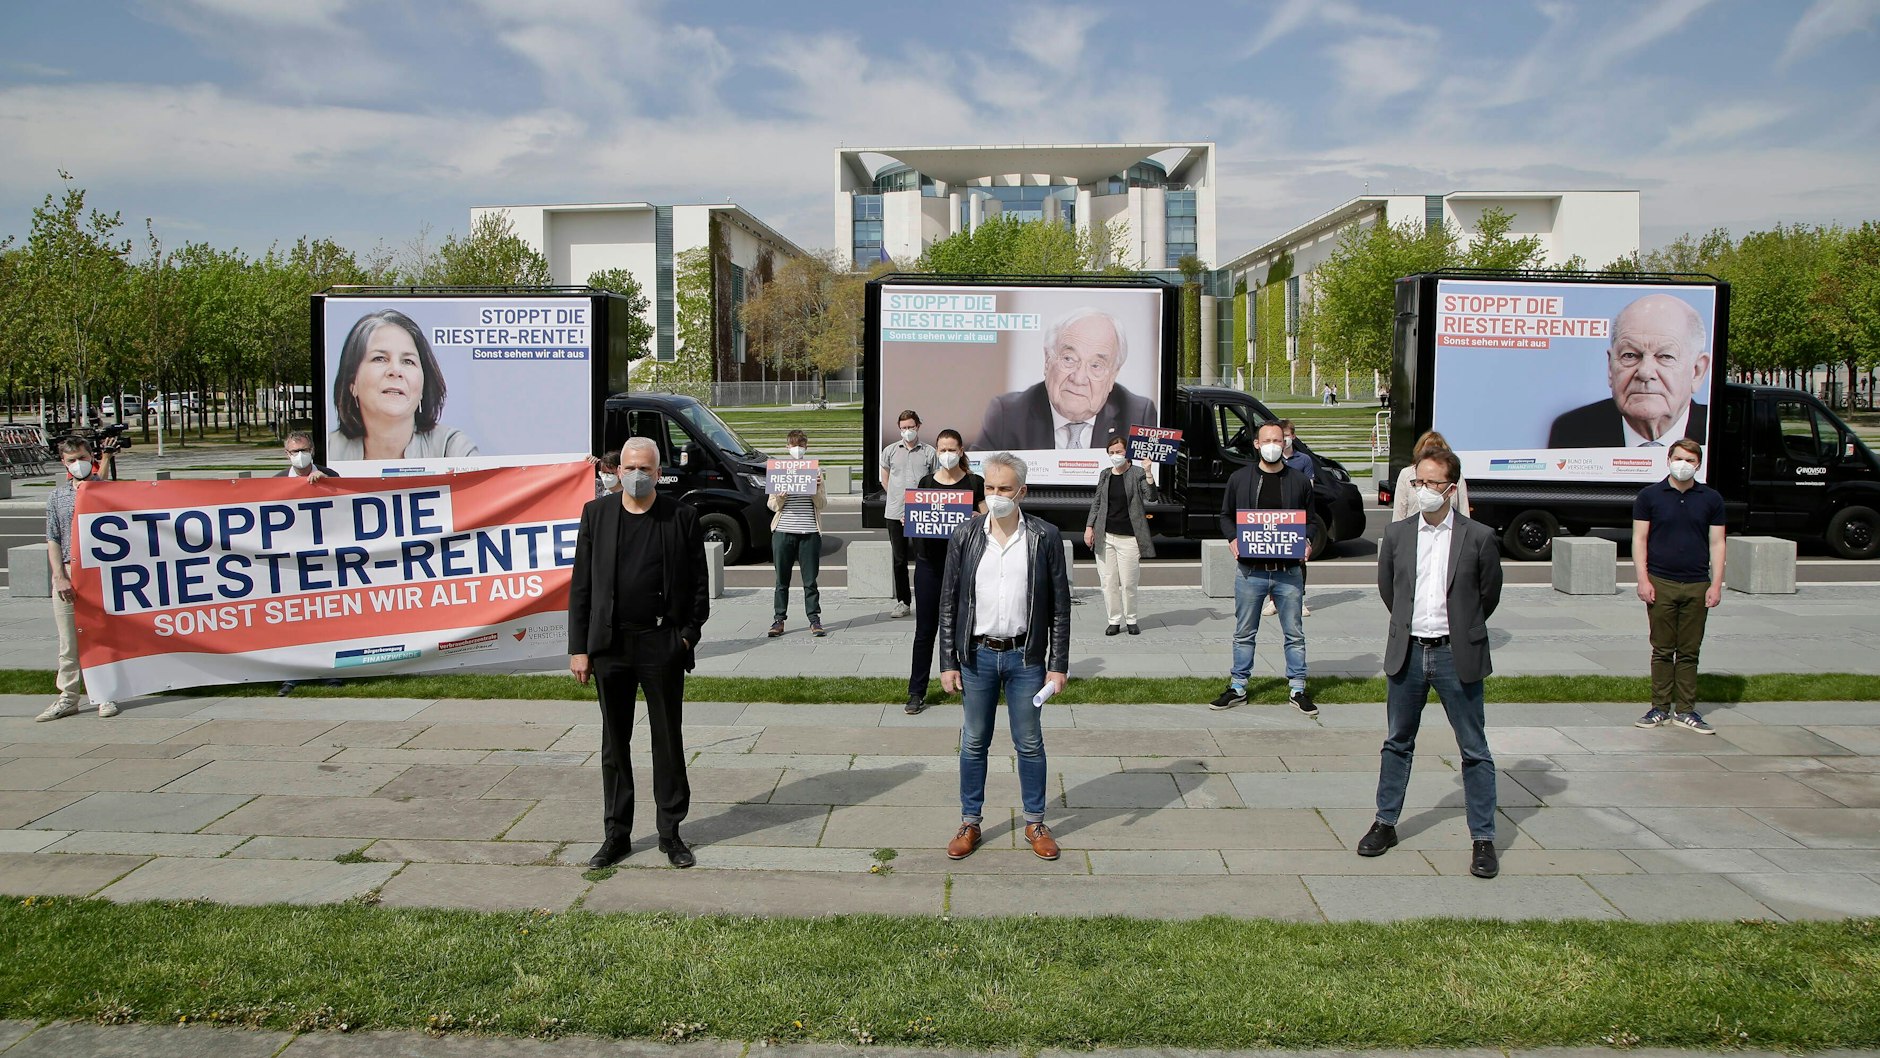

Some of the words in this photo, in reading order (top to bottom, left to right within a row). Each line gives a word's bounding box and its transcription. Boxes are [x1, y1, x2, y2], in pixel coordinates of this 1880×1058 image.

[890, 295, 960, 310] STOPPT
[964, 296, 993, 311] DIE
[1444, 295, 1522, 314] STOPPT
[1526, 298, 1558, 315] DIE
[481, 309, 551, 324] STOPPT
[556, 309, 585, 324] DIE
[890, 313, 1039, 329] RIESTER-RENTE!
[1444, 316, 1608, 337] RIESTER-RENTE!
[434, 329, 584, 344] RIESTER-RENTE!
[889, 331, 916, 340] Sonst
[917, 332, 945, 340] sehen
[947, 332, 962, 341] wir
[963, 332, 976, 341] alt
[977, 333, 994, 341] aus
[1443, 336, 1470, 346] Sonst
[1471, 337, 1499, 347] sehen
[1500, 338, 1514, 347] wir
[1516, 338, 1529, 348] alt
[1530, 339, 1547, 348] aus
[474, 349, 502, 359] Sonst
[504, 349, 533, 359] sehen
[534, 349, 550, 359] wir
[552, 349, 566, 359] alt
[567, 350, 585, 359] aus
[1137, 428, 1176, 439] STOPPT
[1131, 440, 1178, 454] RIESTER-
[1133, 450, 1168, 462] RENTE
[774, 460, 812, 470] STOPPT
[770, 474, 816, 484] RIESTER-
[774, 483, 807, 492] RENTE
[914, 492, 965, 504] STOPPT
[930, 503, 945, 511] DIE
[909, 510, 971, 524] RIESTER-
[1246, 512, 1297, 524] STOPPT
[90, 500, 334, 562] STOPPT
[352, 490, 443, 541] DIE
[1263, 523, 1278, 531] DIE
[1242, 530, 1304, 543] RIESTER-
[1248, 543, 1293, 555] RENTE
[111, 522, 580, 612] RIESTER-RENTE
[153, 603, 257, 637] SONST
[264, 592, 362, 624] SEHEN
[369, 586, 423, 613] WIR
[430, 580, 481, 607] ALT
[489, 575, 543, 602] AUS
[528, 625, 549, 633] BUND
[528, 630, 568, 640] VERSICHER
[362, 651, 418, 664] FINANZWENDE
